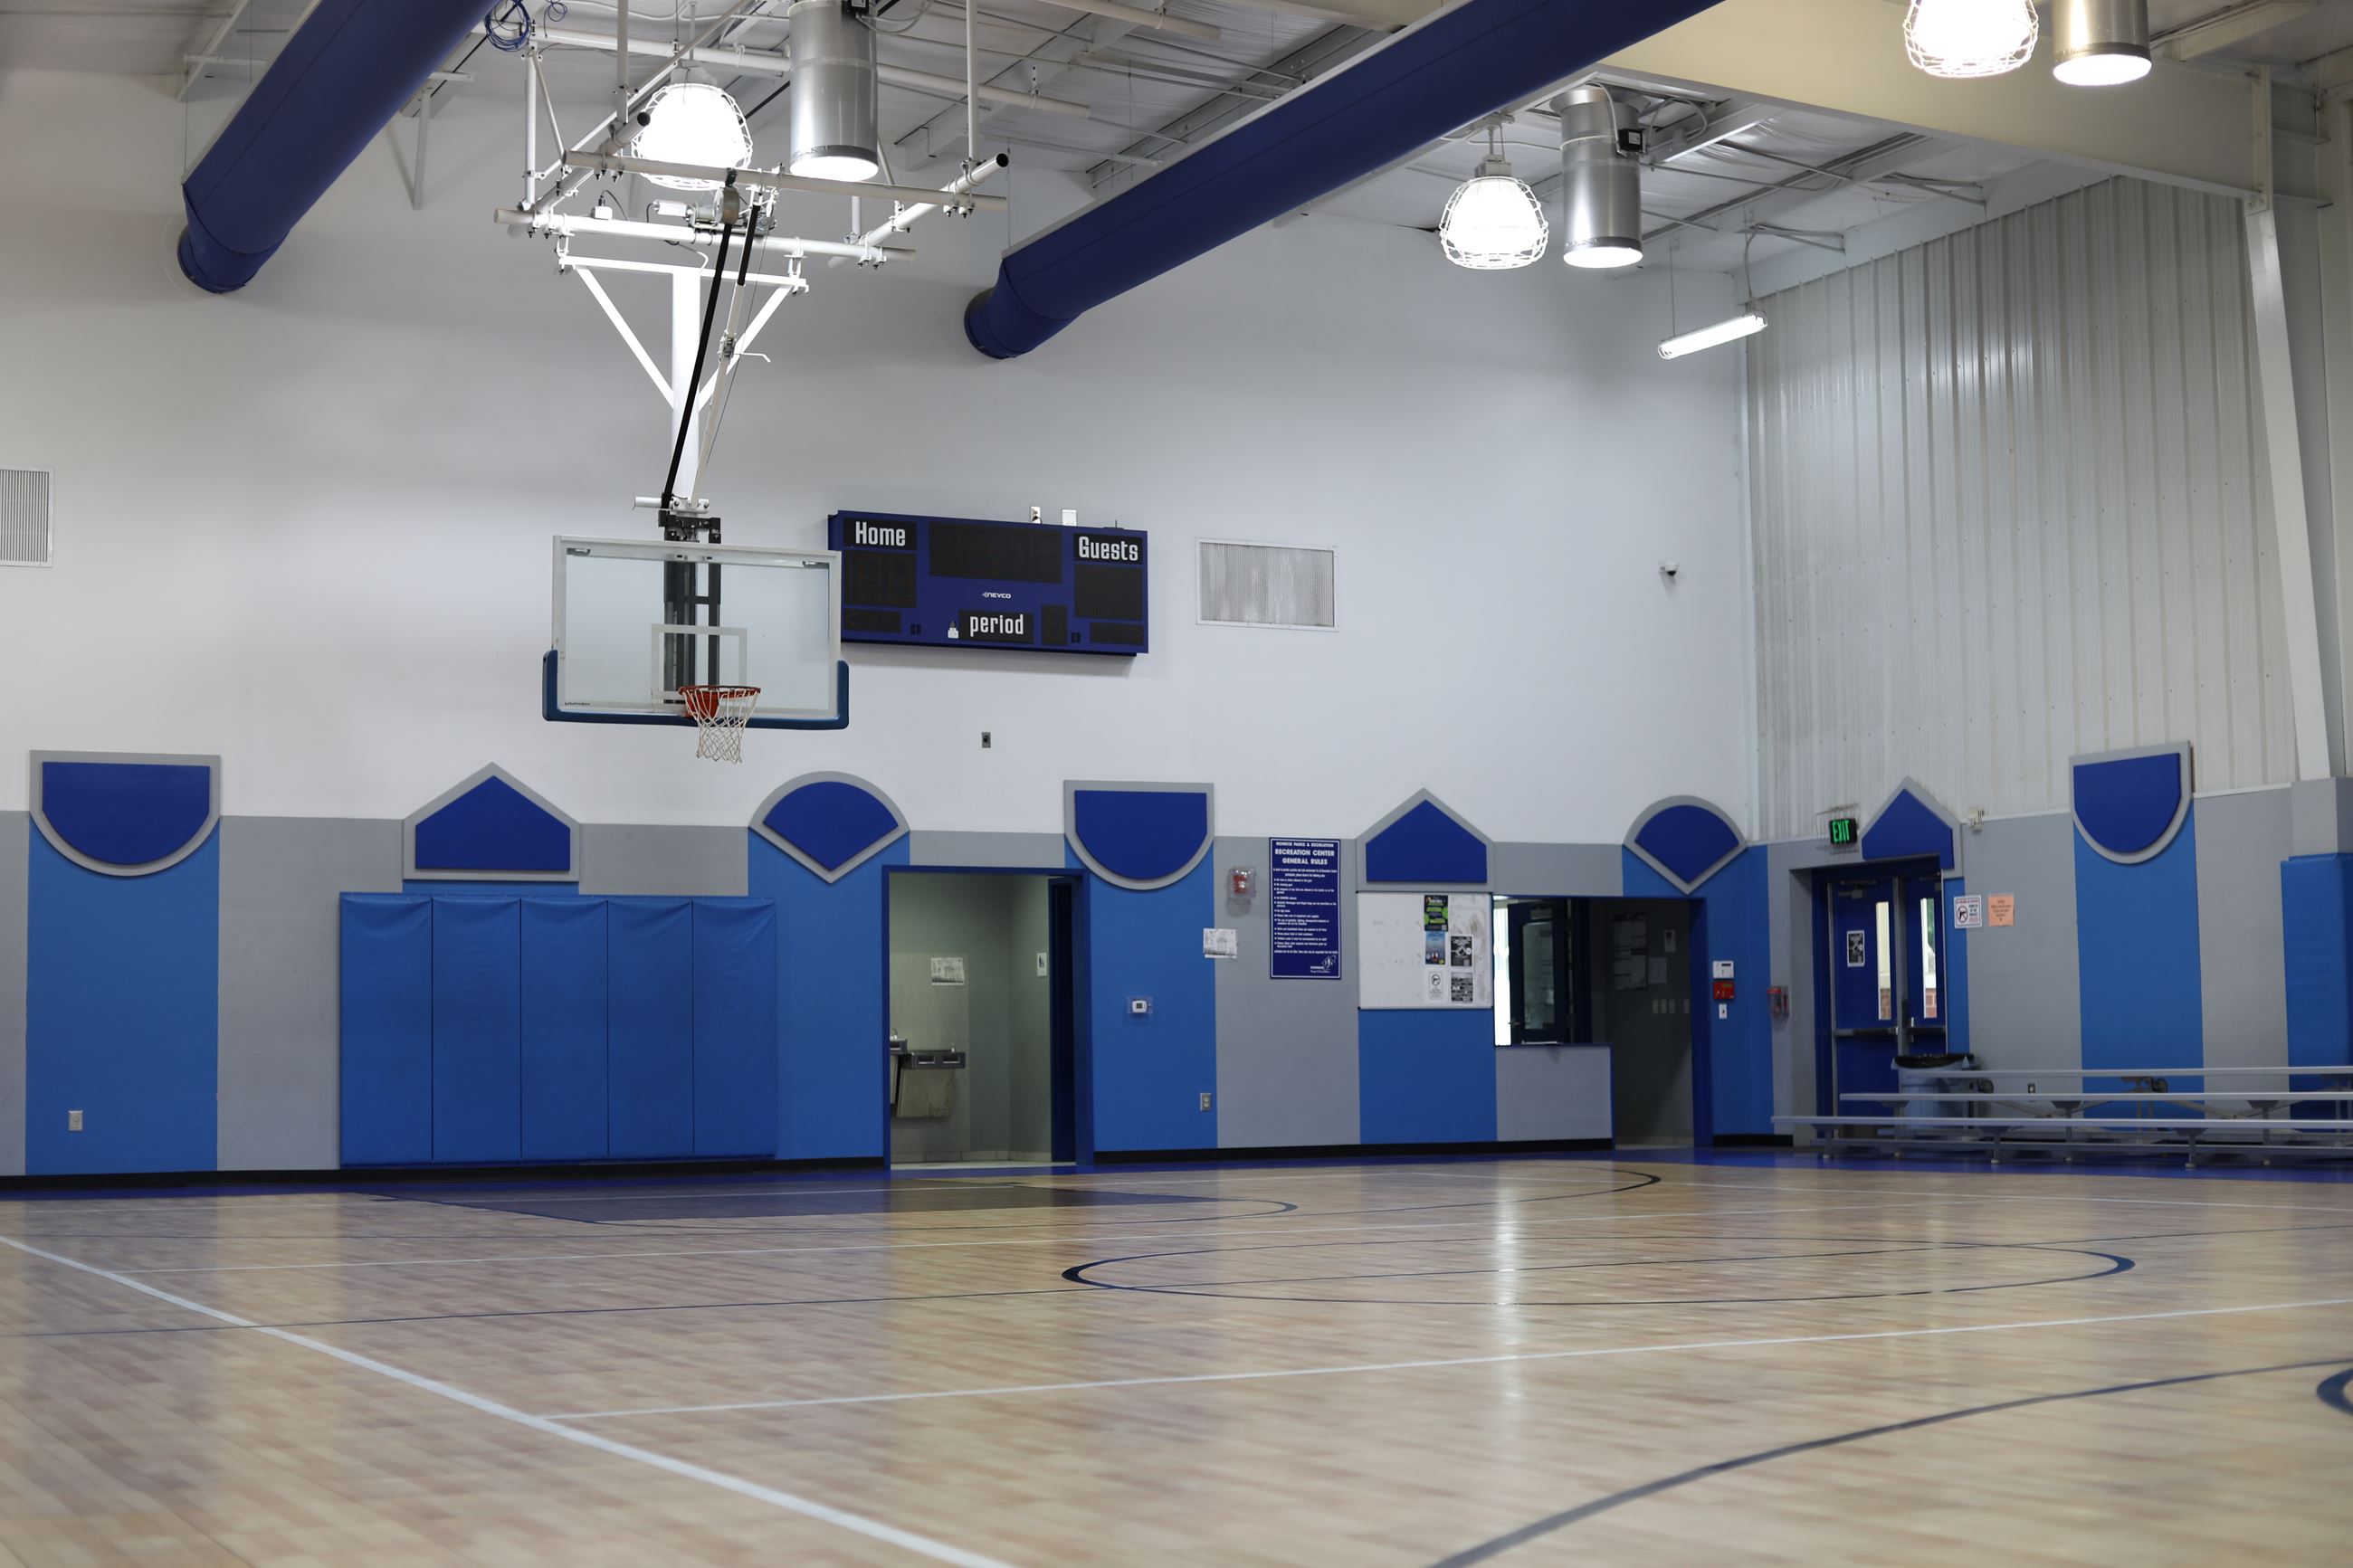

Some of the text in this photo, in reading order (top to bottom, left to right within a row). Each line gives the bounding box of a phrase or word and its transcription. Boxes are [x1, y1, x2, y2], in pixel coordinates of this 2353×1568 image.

[855, 521, 906, 546] Home
[1079, 536, 1138, 561] Guests
[969, 613, 1024, 637] period
[1832, 820, 1849, 842] EXIT
